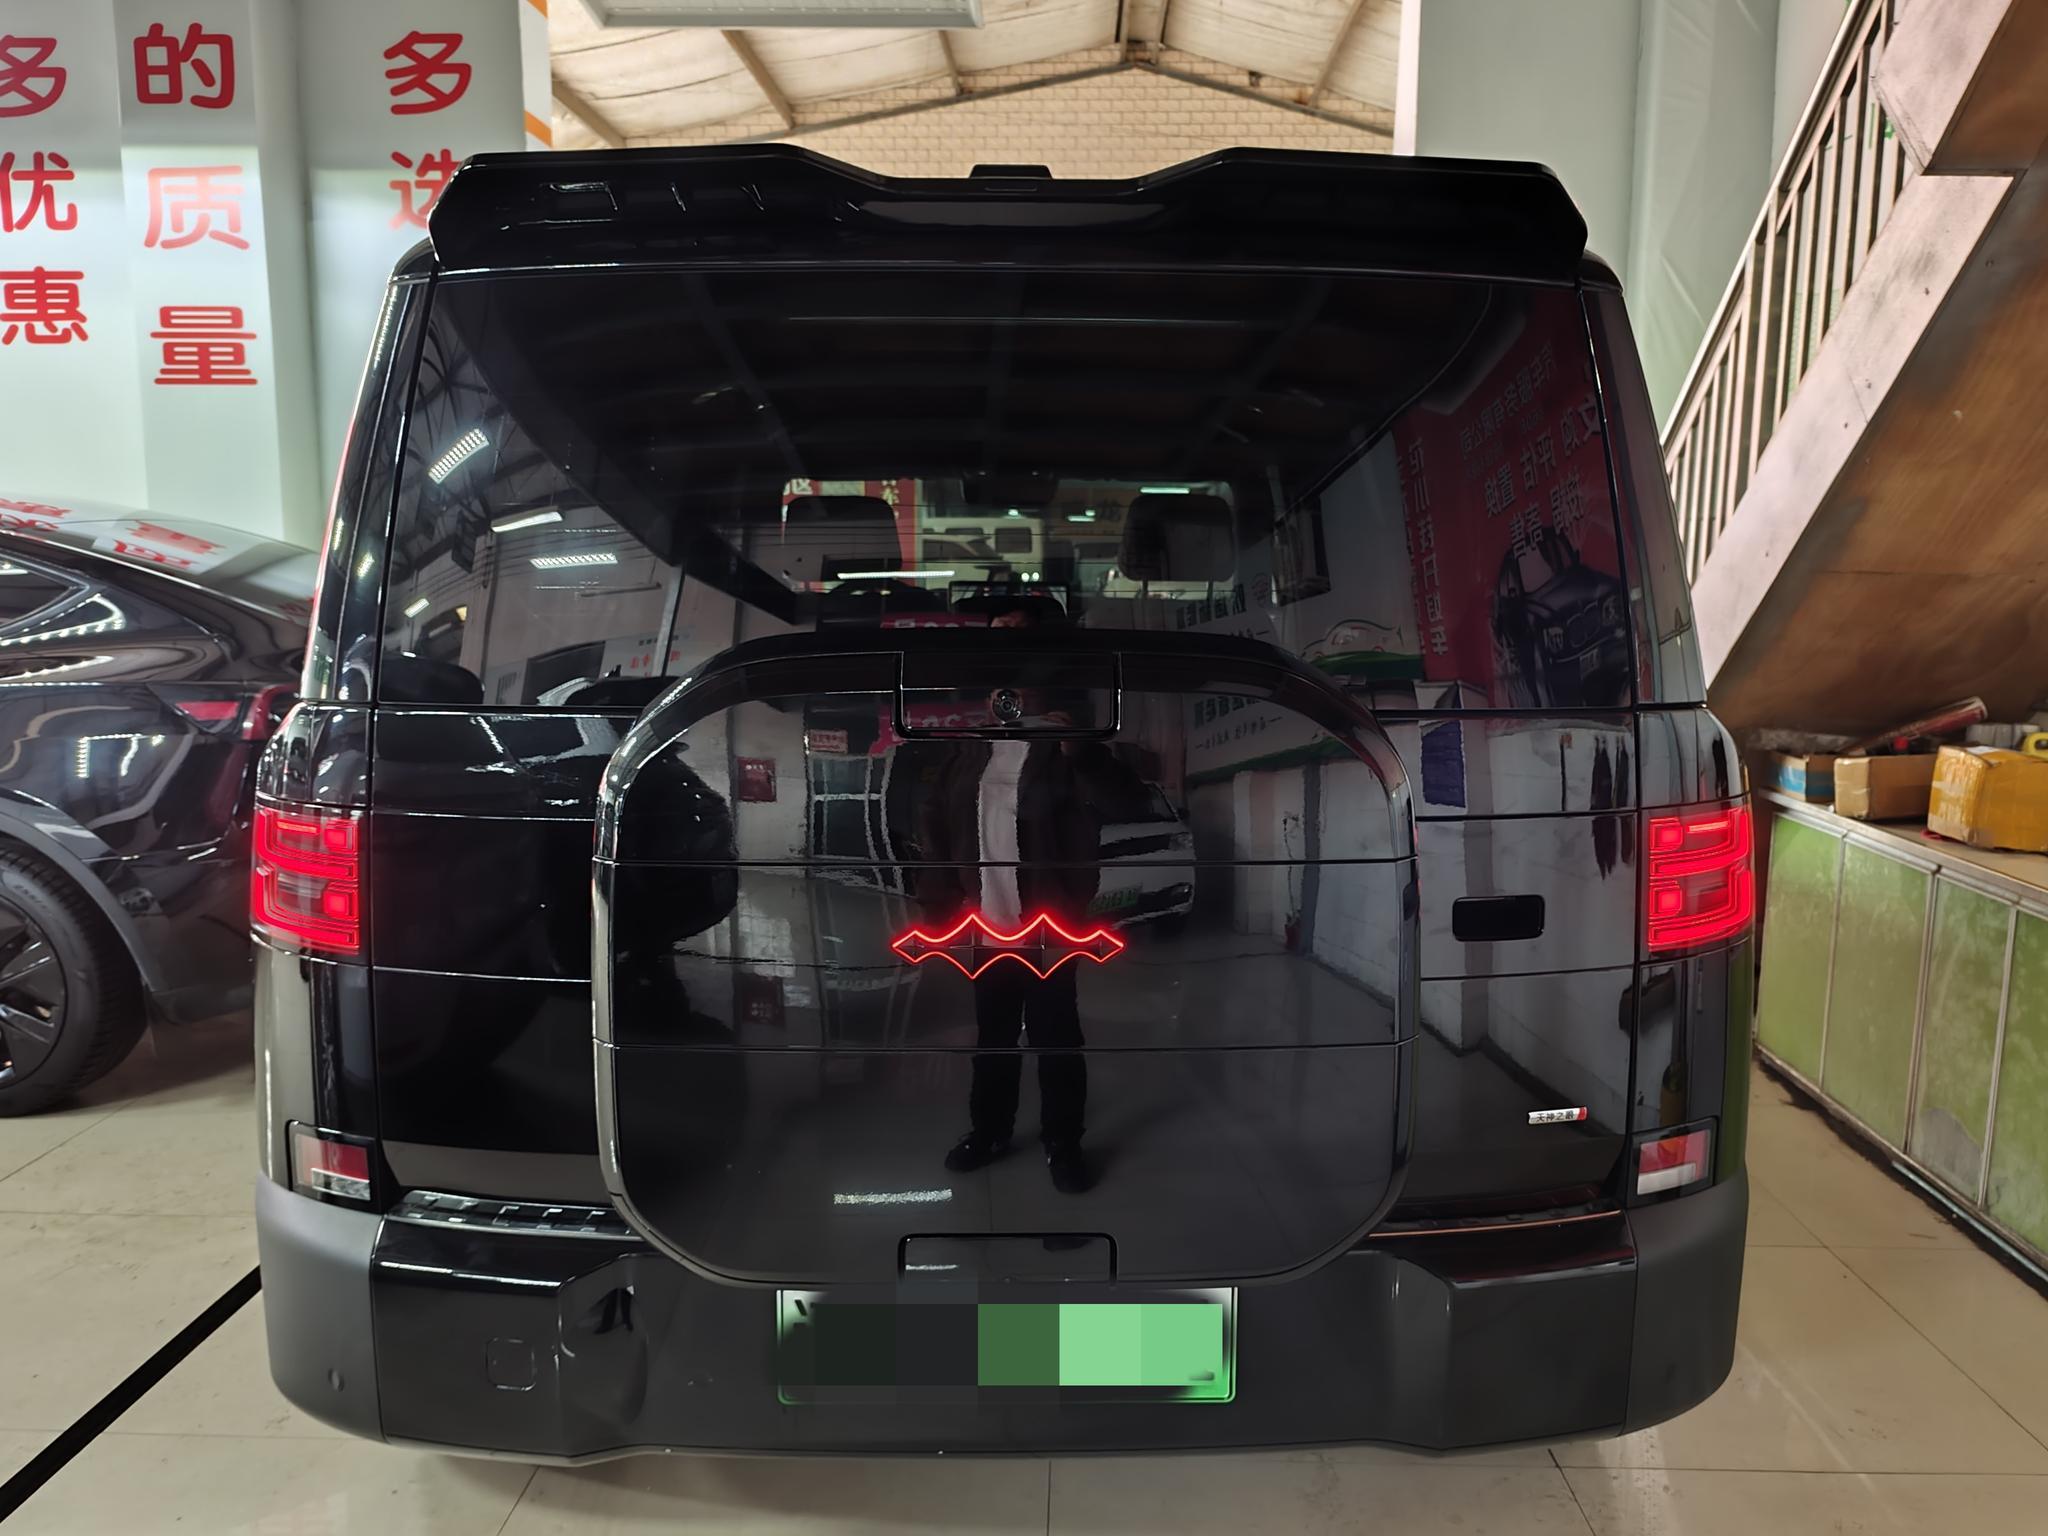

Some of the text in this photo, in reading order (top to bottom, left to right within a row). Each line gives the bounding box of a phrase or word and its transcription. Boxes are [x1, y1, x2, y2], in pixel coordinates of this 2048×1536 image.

[0, 34, 89, 346] 多优惠
[133, 22, 258, 386] 的质量
